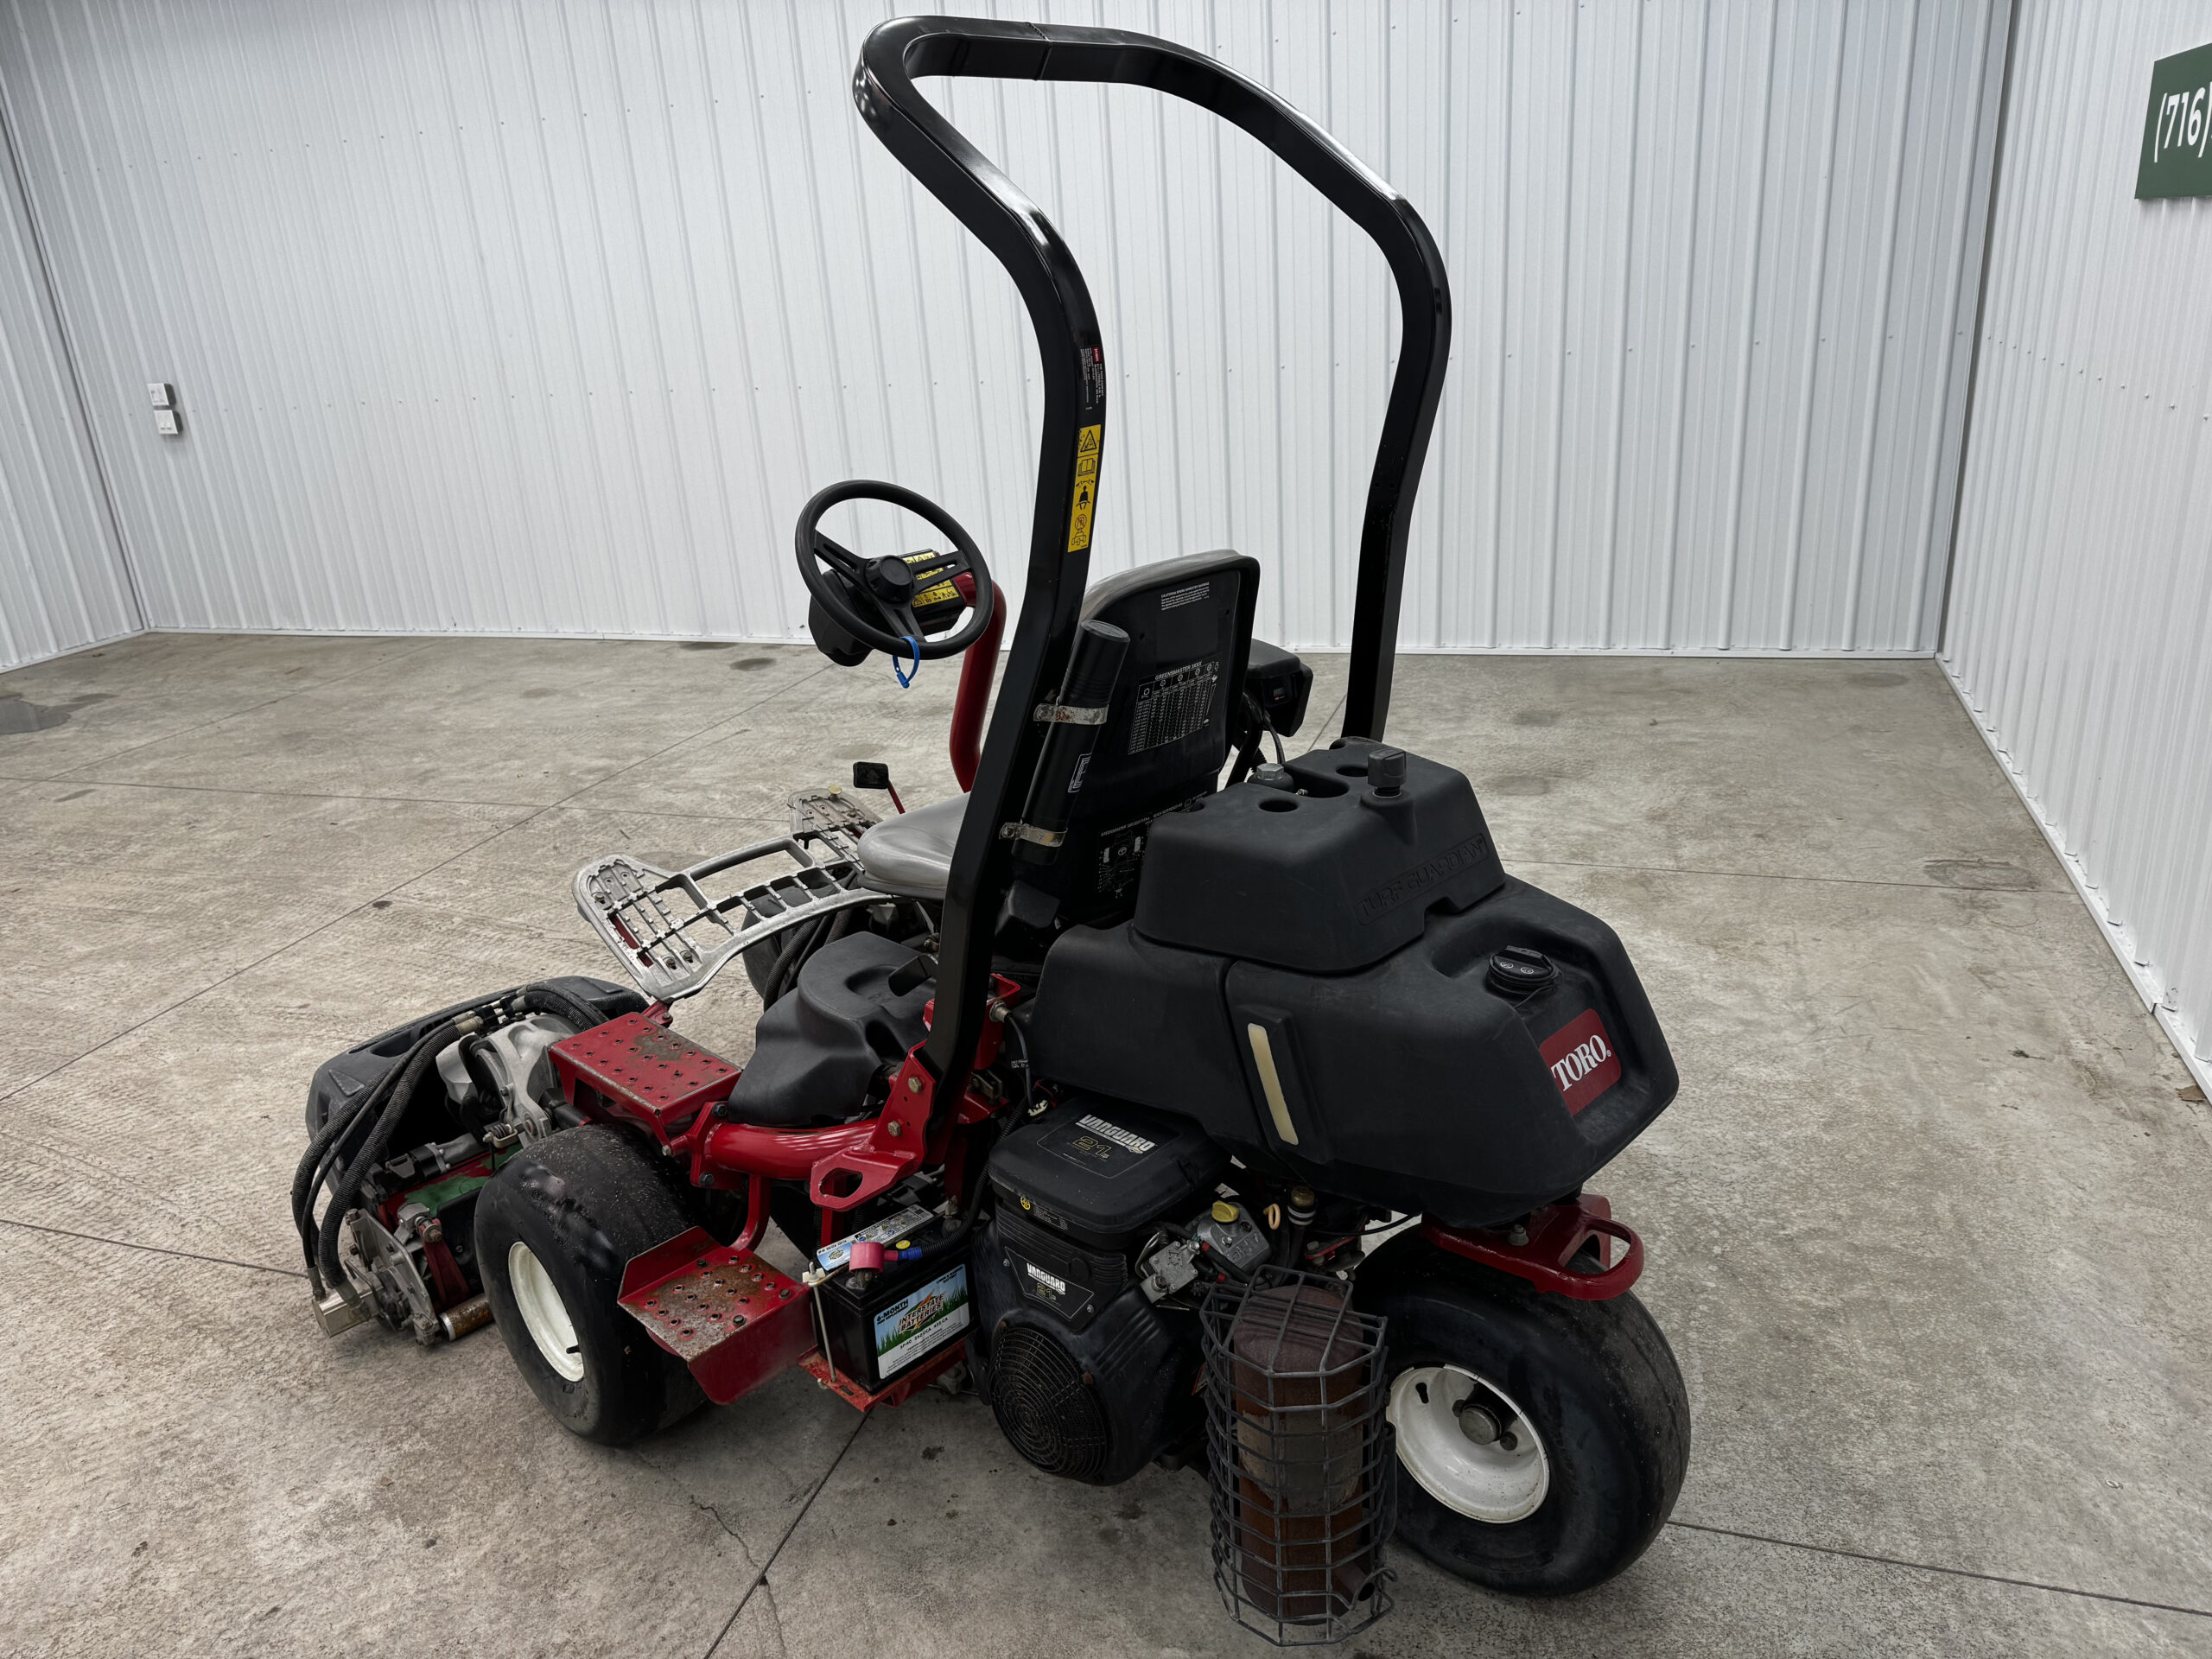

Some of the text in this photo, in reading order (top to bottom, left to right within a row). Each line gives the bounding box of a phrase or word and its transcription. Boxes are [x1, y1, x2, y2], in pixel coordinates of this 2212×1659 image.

[1360, 842, 1483, 916] TURF GUARDIAN
[1550, 1034, 1608, 1091] TORO
[1072, 1135, 1112, 1157] 21
[1077, 1114, 1157, 1152] VANGUARD
[1027, 1262, 1066, 1293] VANGUARD
[1036, 1282, 1053, 1298] 21
[876, 1299, 909, 1322] 6-MONTH
[899, 1294, 944, 1325] INTERSTATE
[900, 1303, 942, 1332] BATTERIES
